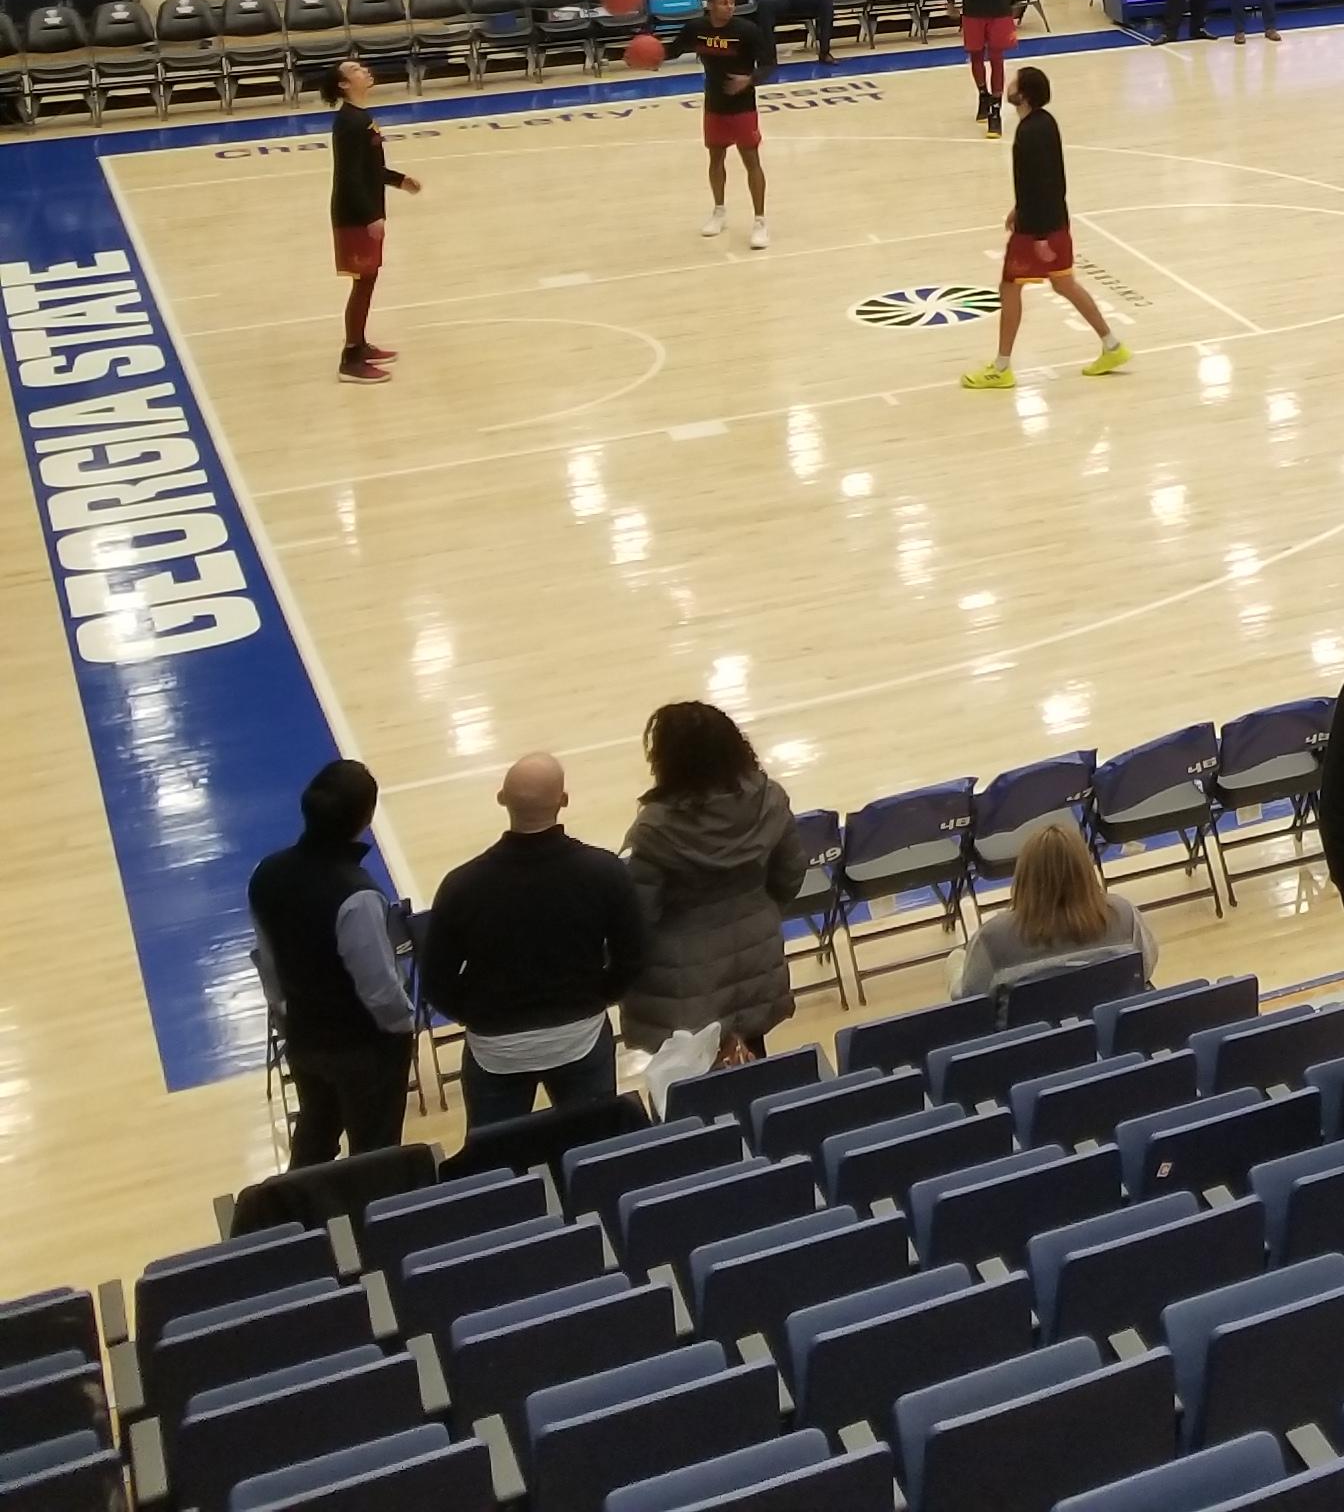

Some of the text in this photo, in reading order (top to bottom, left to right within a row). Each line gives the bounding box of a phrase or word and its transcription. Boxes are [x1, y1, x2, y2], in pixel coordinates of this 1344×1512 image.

[1, 249, 167, 388] STATE
[26, 381, 263, 664] GEORGIA
[808, 846, 842, 868] 49
